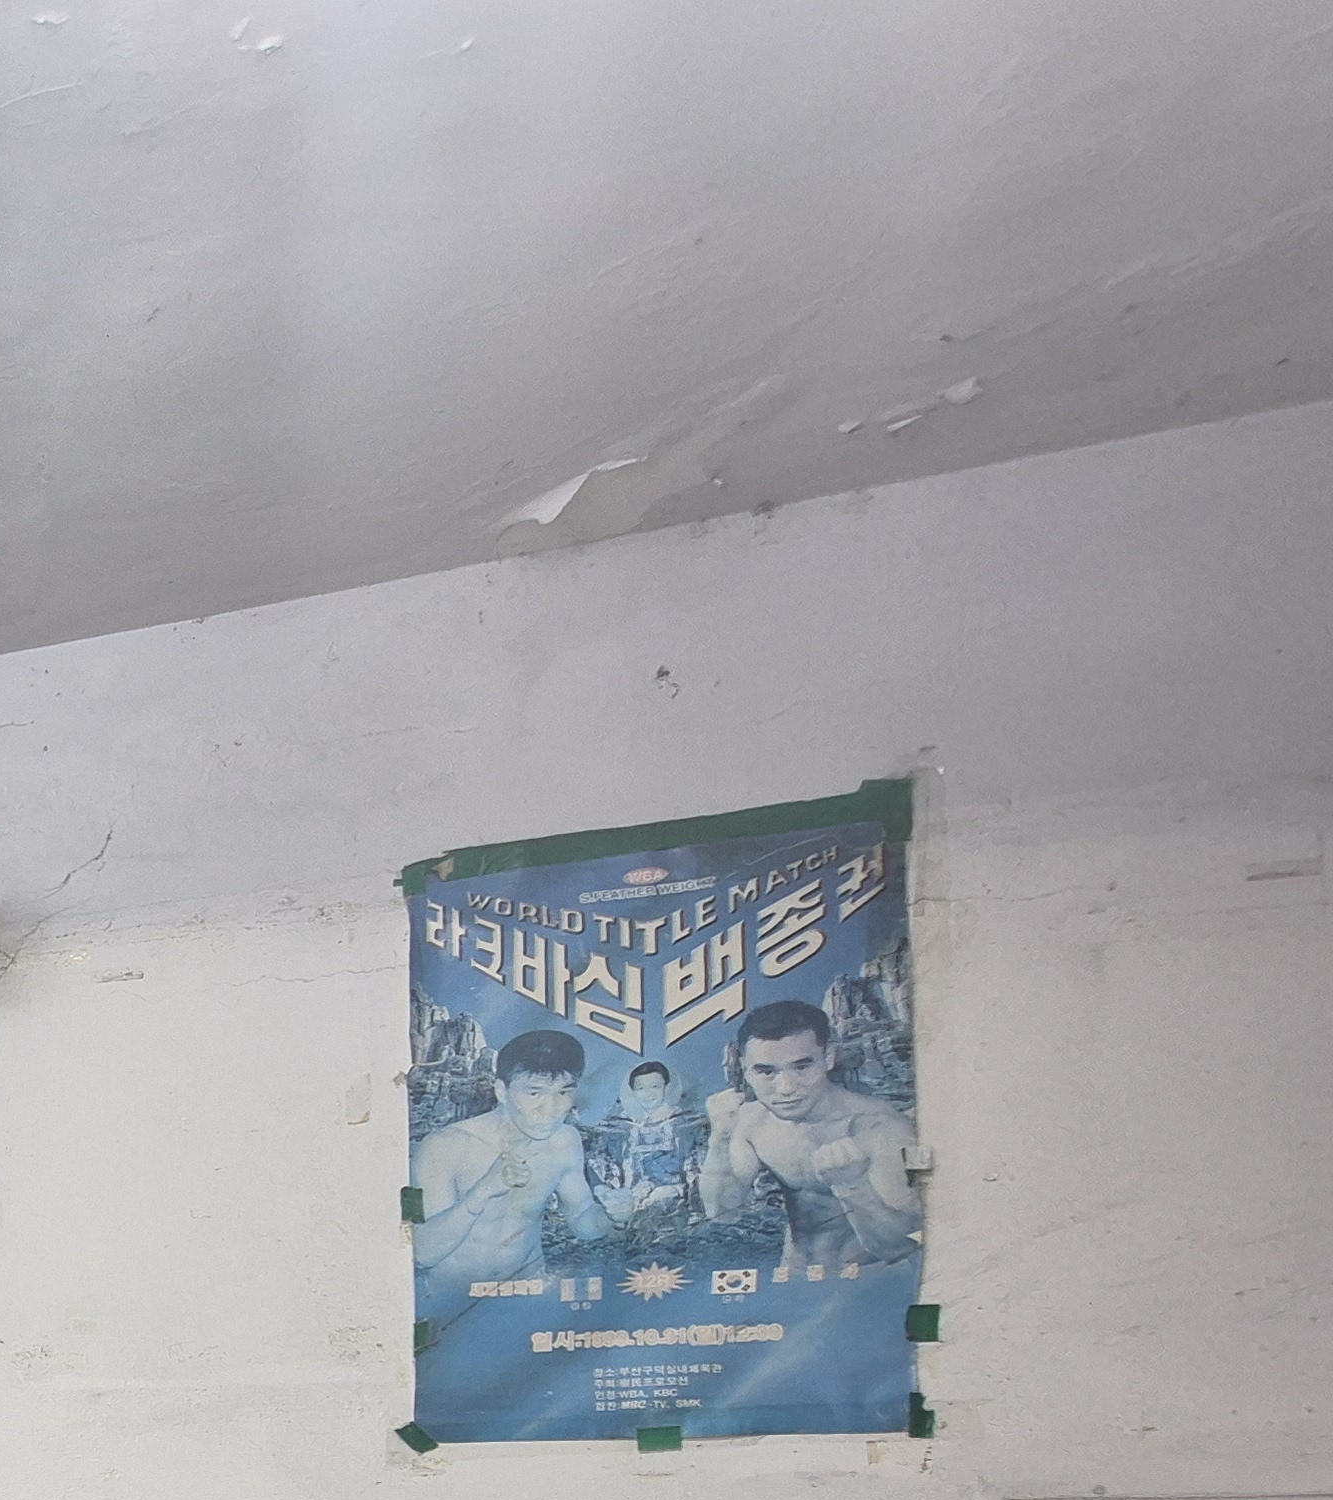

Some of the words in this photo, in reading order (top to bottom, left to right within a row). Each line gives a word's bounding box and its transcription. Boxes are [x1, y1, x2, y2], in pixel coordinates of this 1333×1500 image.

[426, 897, 645, 1057] 라크바심
[662, 841, 887, 1050] 백종권
[466, 890, 585, 935] WORLD
[592, 895, 719, 956] TITLE
[728, 844, 839, 912] MATCH
